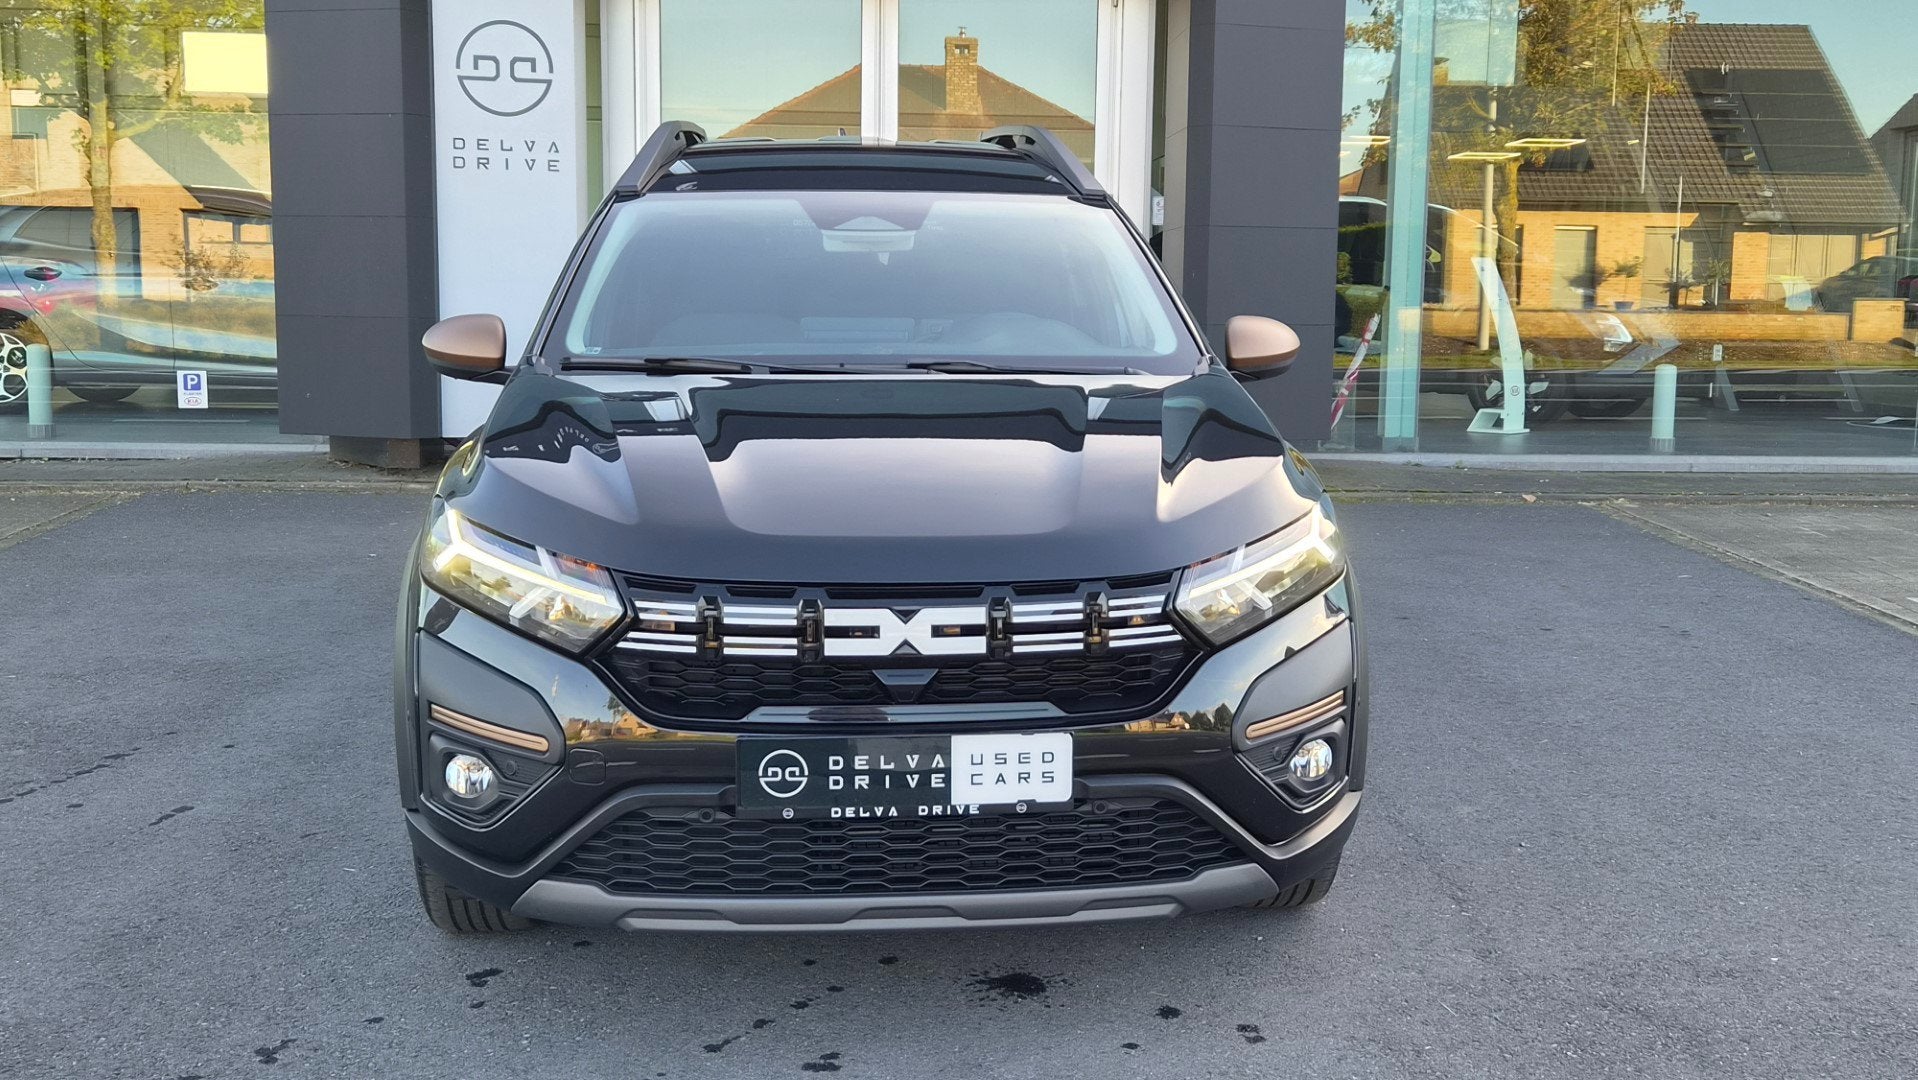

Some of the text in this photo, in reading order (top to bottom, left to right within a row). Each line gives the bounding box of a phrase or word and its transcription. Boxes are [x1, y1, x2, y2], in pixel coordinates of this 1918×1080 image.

[453, 137, 560, 153] DELVA
[453, 156, 560, 172] DRIVE
[186, 375, 198, 390] P
[828, 753, 945, 770] DELVA
[970, 751, 1055, 766] USED
[828, 773, 945, 790] DRIVE
[970, 771, 1055, 786] CARS
[830, 804, 980, 818] DELVA DRIVE
